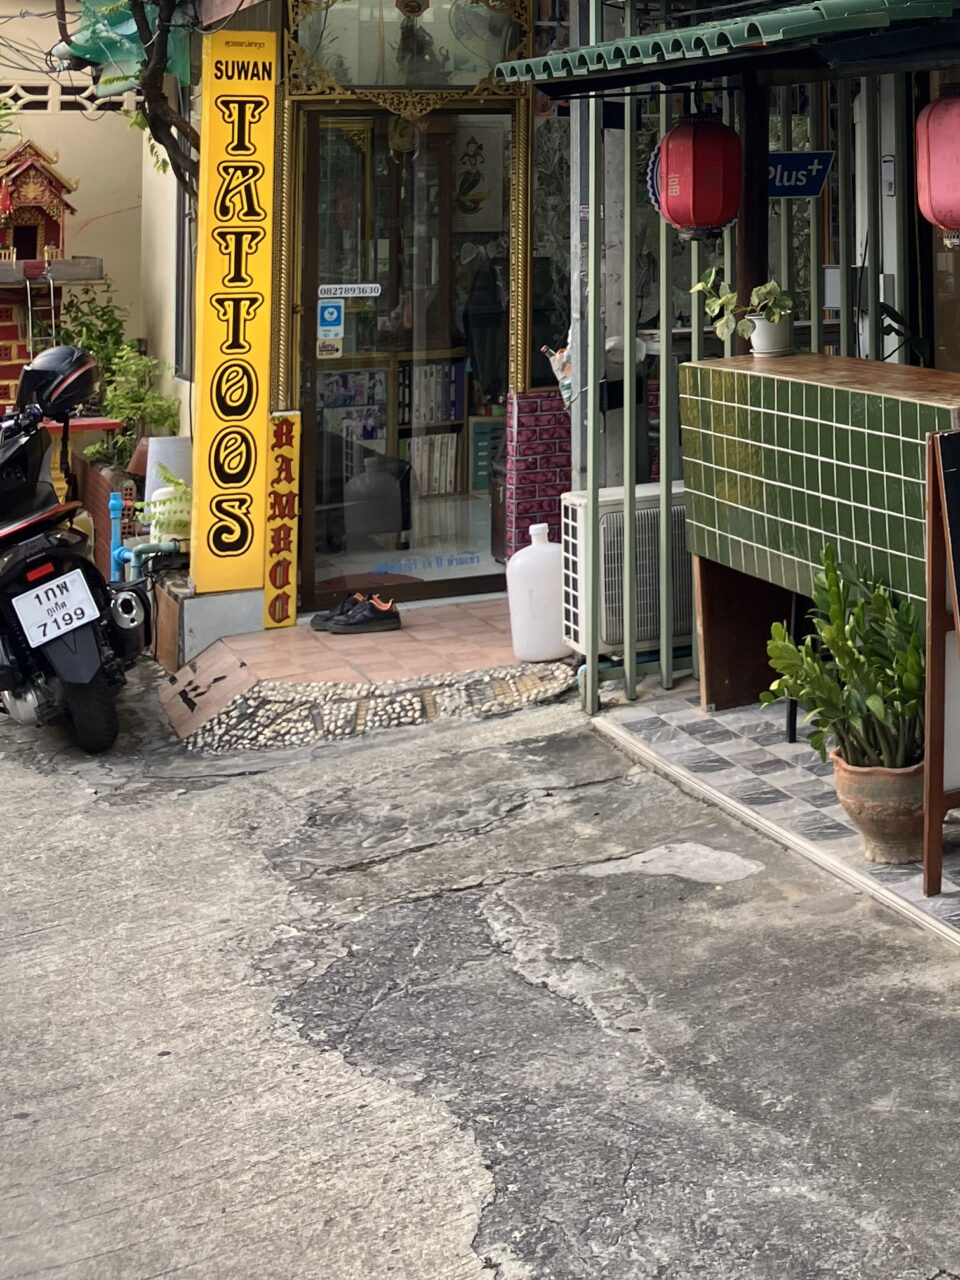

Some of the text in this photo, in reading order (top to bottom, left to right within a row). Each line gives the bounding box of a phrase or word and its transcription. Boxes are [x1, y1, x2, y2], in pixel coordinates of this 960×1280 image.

[214, 60, 272, 81] SUWAN
[320, 286, 380, 296] 0827893630
[206, 93, 270, 559] TATTOOS
[37, 606, 86, 638] 7199
